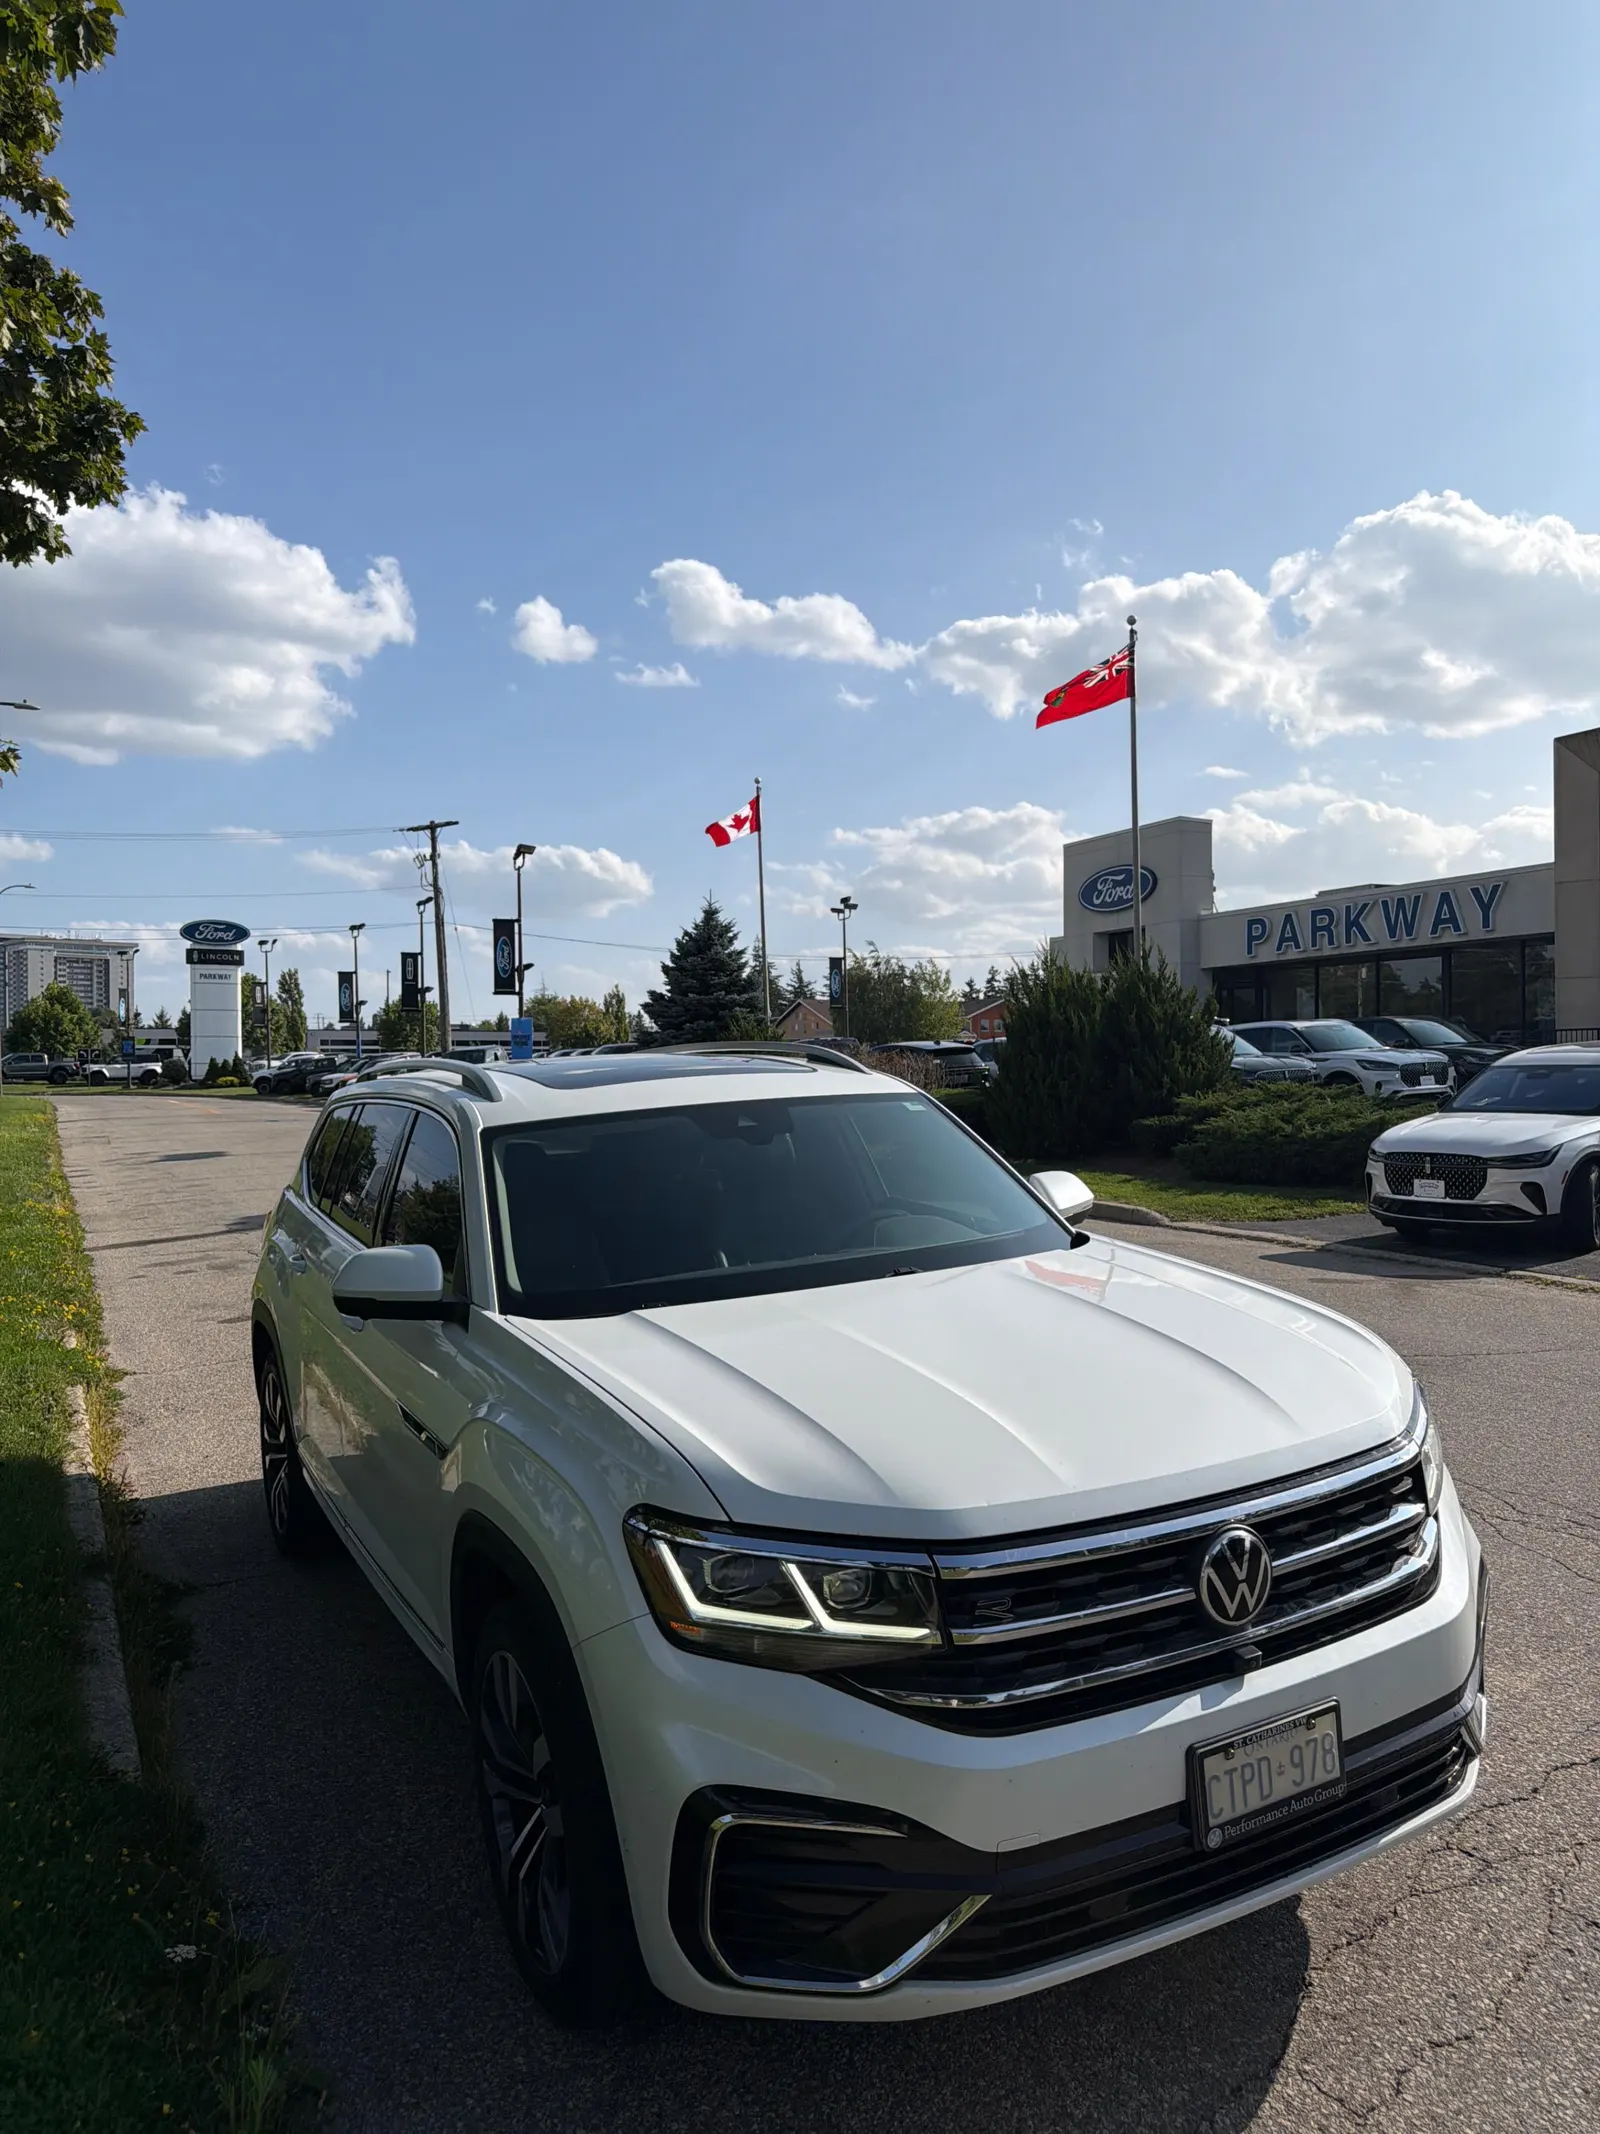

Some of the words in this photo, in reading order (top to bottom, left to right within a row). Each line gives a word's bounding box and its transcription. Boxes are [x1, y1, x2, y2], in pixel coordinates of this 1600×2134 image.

[1093, 873, 1134, 905] Ford
[195, 923, 237, 941] Ford
[1245, 881, 1507, 957] PARKWAY
[201, 953, 240, 961] LINCOLN
[499, 944, 510, 970] Ford
[199, 972, 232, 981] PARKWAY
[1233, 1739, 1246, 1749] ST.
[1246, 1721, 1295, 1745] CATHARINES
[1295, 1716, 1308, 1727] VW
[1207, 1756, 1273, 1819] CTPD
[1289, 1731, 1336, 1787] 978
[1223, 1804, 1289, 1838] Performance
[1289, 1797, 1314, 1814] Auto
[1314, 1782, 1345, 1802] Group
